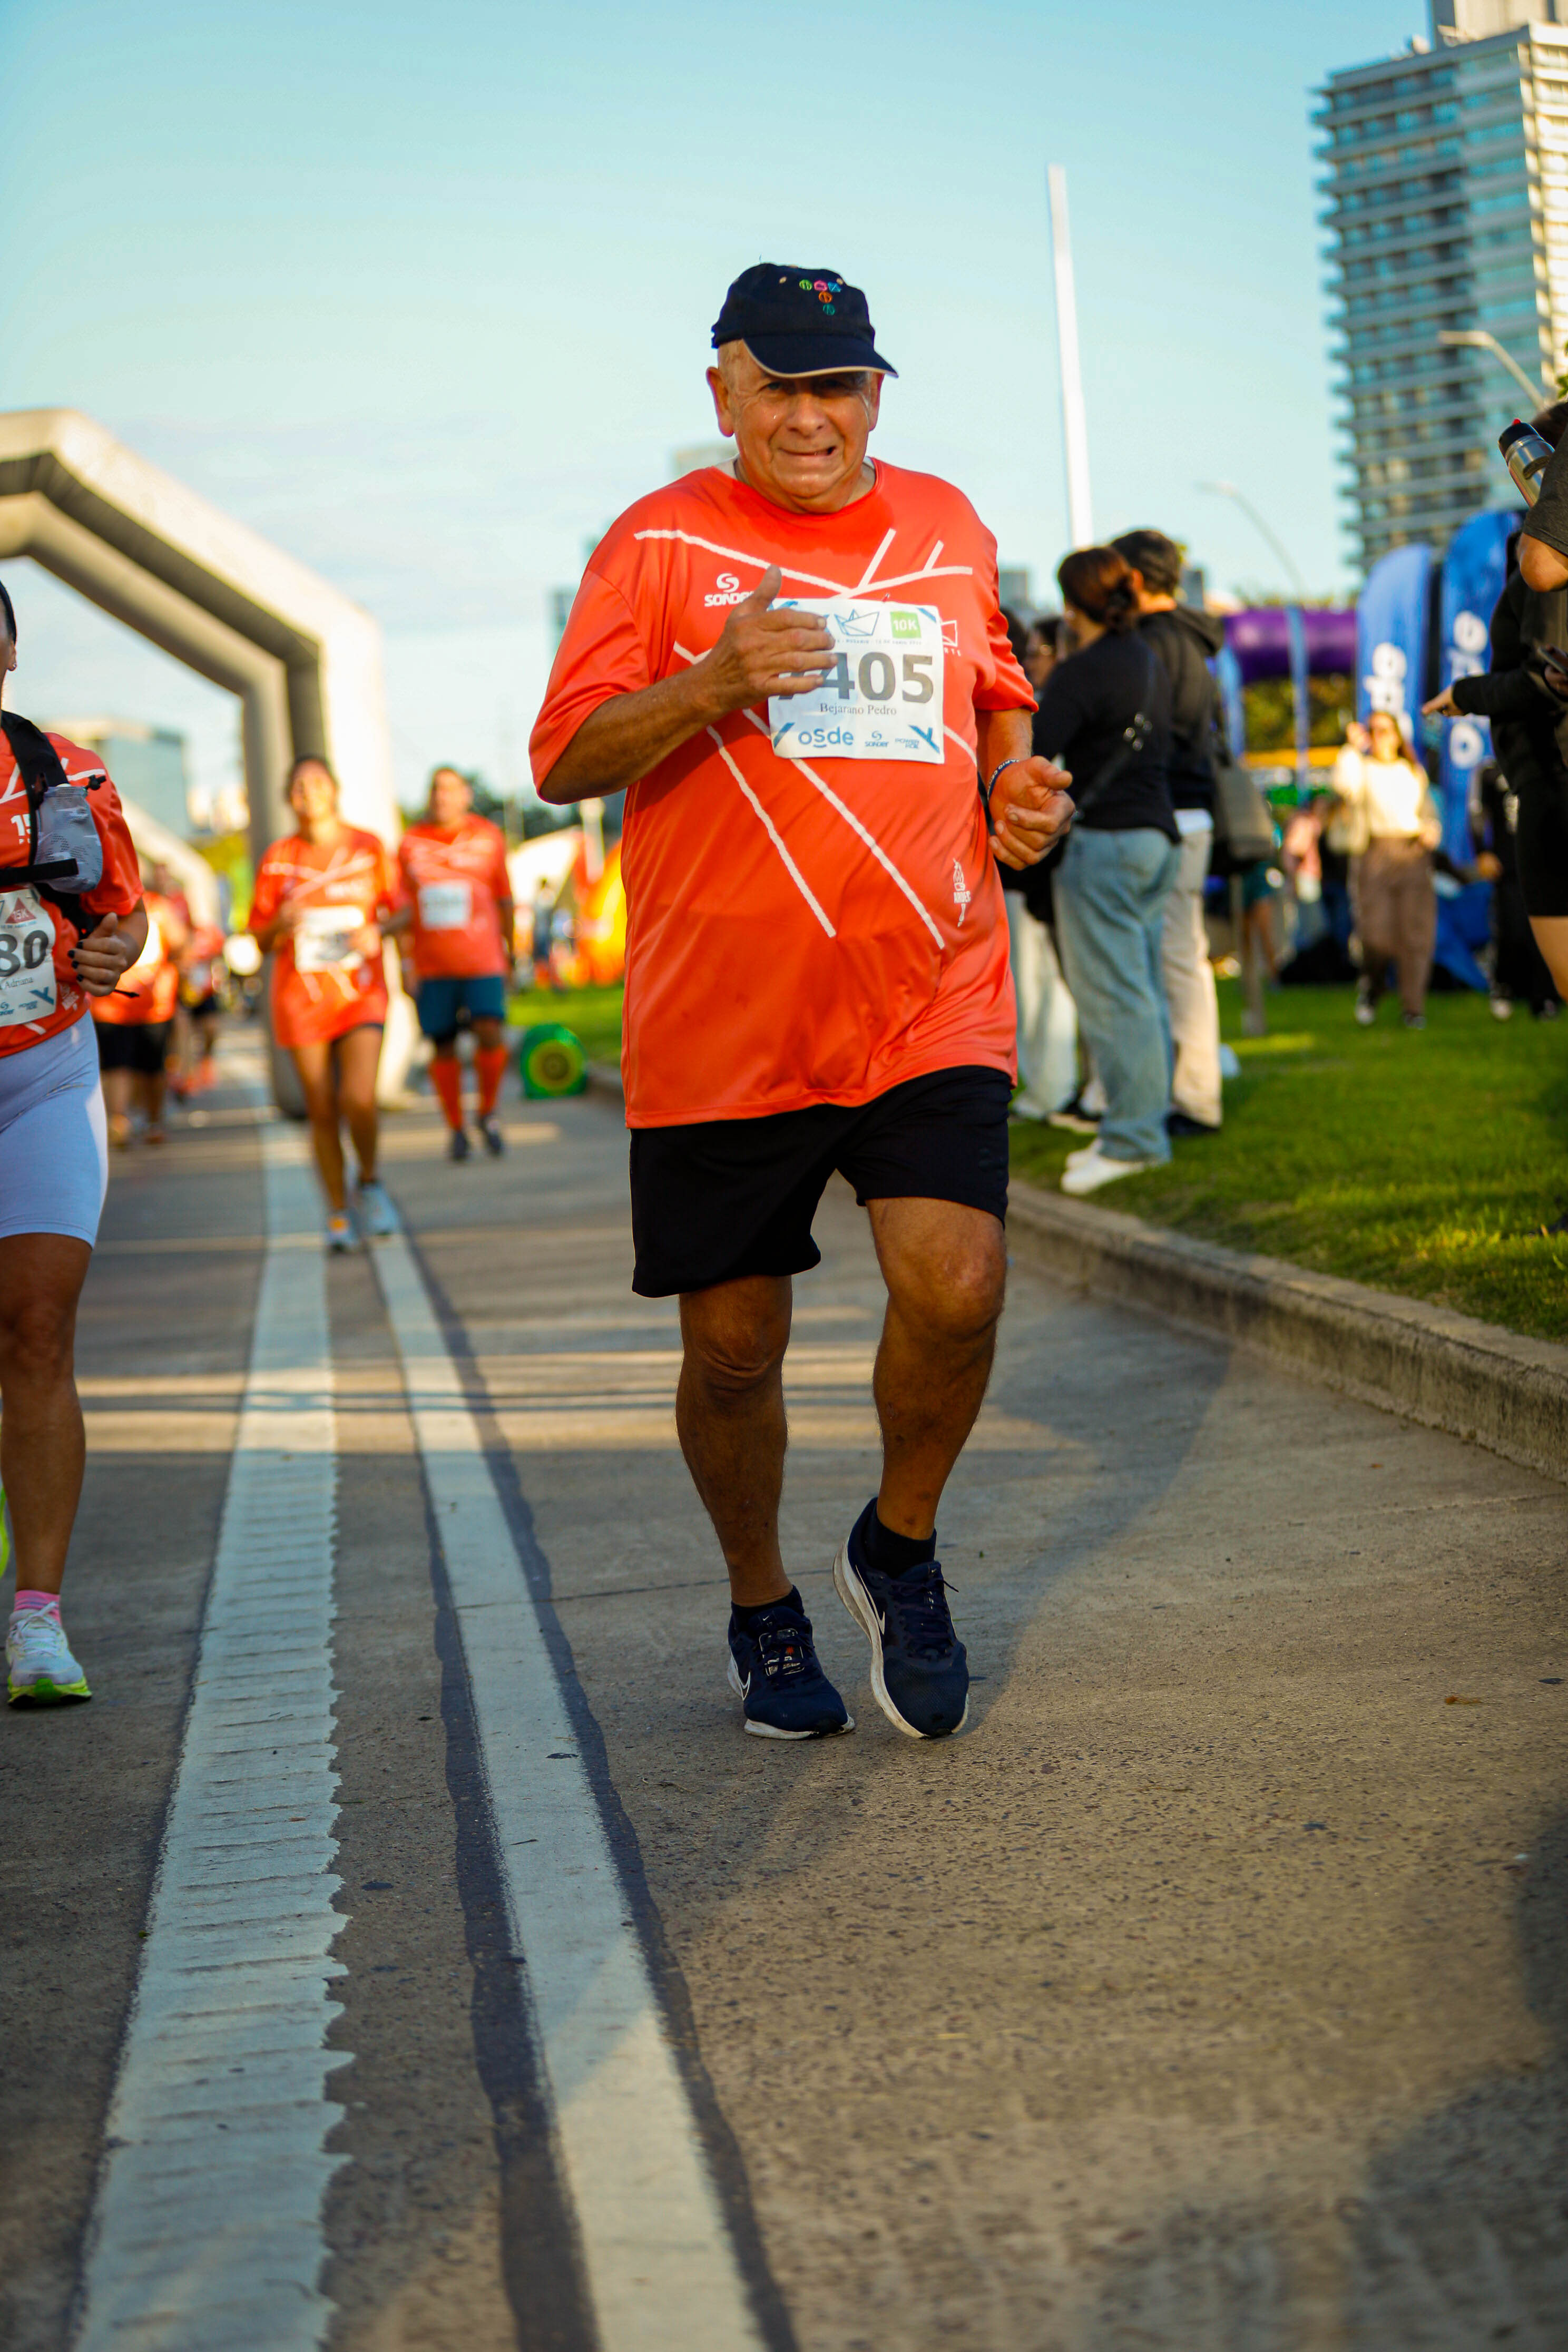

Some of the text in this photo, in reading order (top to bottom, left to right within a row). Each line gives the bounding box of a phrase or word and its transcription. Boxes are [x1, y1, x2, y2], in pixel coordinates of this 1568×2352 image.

[893, 619, 917, 631] 10K
[820, 702, 897, 715] Bejarano Pedro
[798, 726, 854, 748] osde
